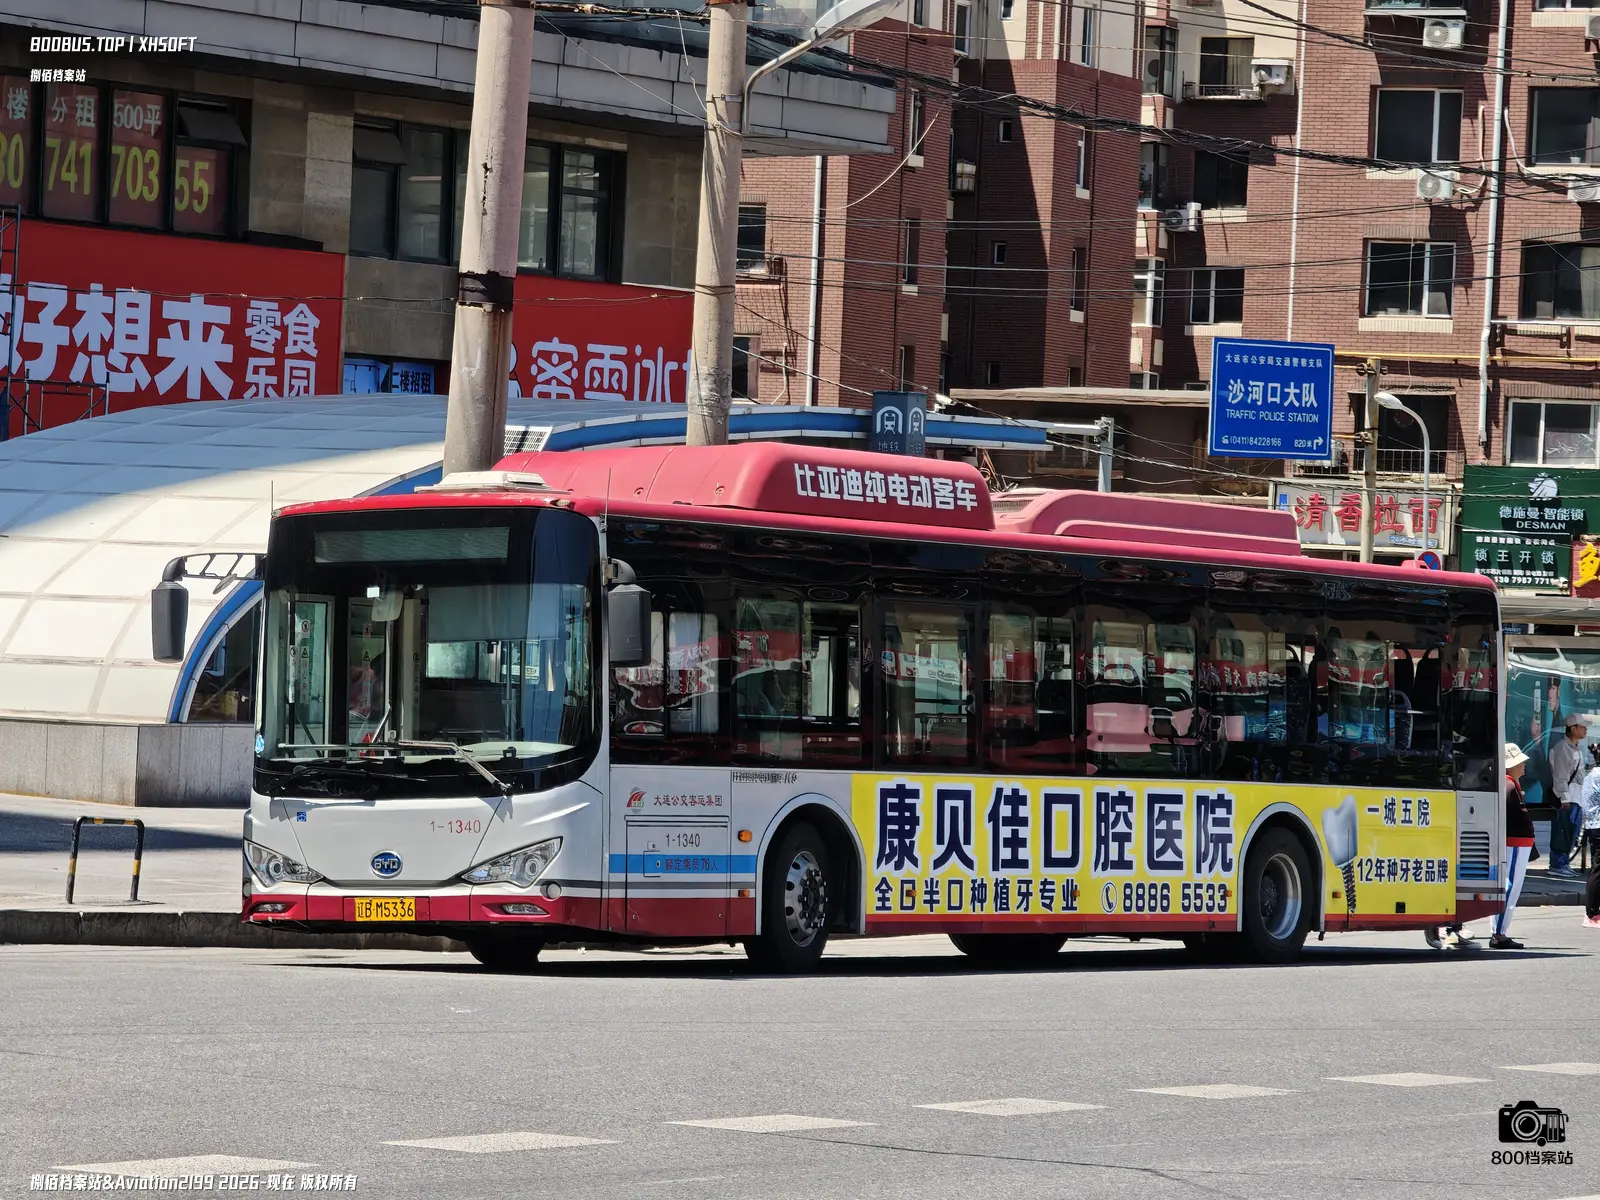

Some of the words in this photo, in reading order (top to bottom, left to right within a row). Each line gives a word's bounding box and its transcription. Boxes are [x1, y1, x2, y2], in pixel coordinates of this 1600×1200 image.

[7, 86, 29, 120] 楼
[113, 103, 162, 137] 500平
[45, 137, 92, 195] 741
[111, 145, 160, 202] 703
[174, 159, 210, 213] 55
[0, 273, 234, 400] 好想来
[245, 299, 320, 358] 零食
[243, 356, 316, 399] 乐园
[530, 336, 692, 403] 蜜雪冰
[1227, 378, 1318, 408] 沙河口大队
[1225, 408, 1257, 420] TRAFFIC
[1259, 410, 1285, 422] POLICE
[1287, 412, 1319, 424] STATION
[877, 441, 900, 452] 地铁
[793, 463, 978, 512] 比亚迪纯电动客车
[1294, 491, 1443, 535] 清香拉面
[1516, 520, 1566, 530] DESMAN
[1474, 547, 1555, 565] 锁王开锁
[653, 794, 723, 807] 大连公交客运集团
[1367, 797, 1430, 826] 一城五院
[430, 819, 481, 834] 1-1340
[665, 833, 701, 848] 1-1340
[876, 783, 1234, 875] 康贝佳口腔医院
[374, 858, 399, 870] BYD
[1356, 857, 1449, 883] 12年种牙老品牌
[875, 876, 1079, 912] 全口半口种植牙专业
[1123, 882, 1171, 912] 8886
[1181, 882, 1229, 913] 5533
